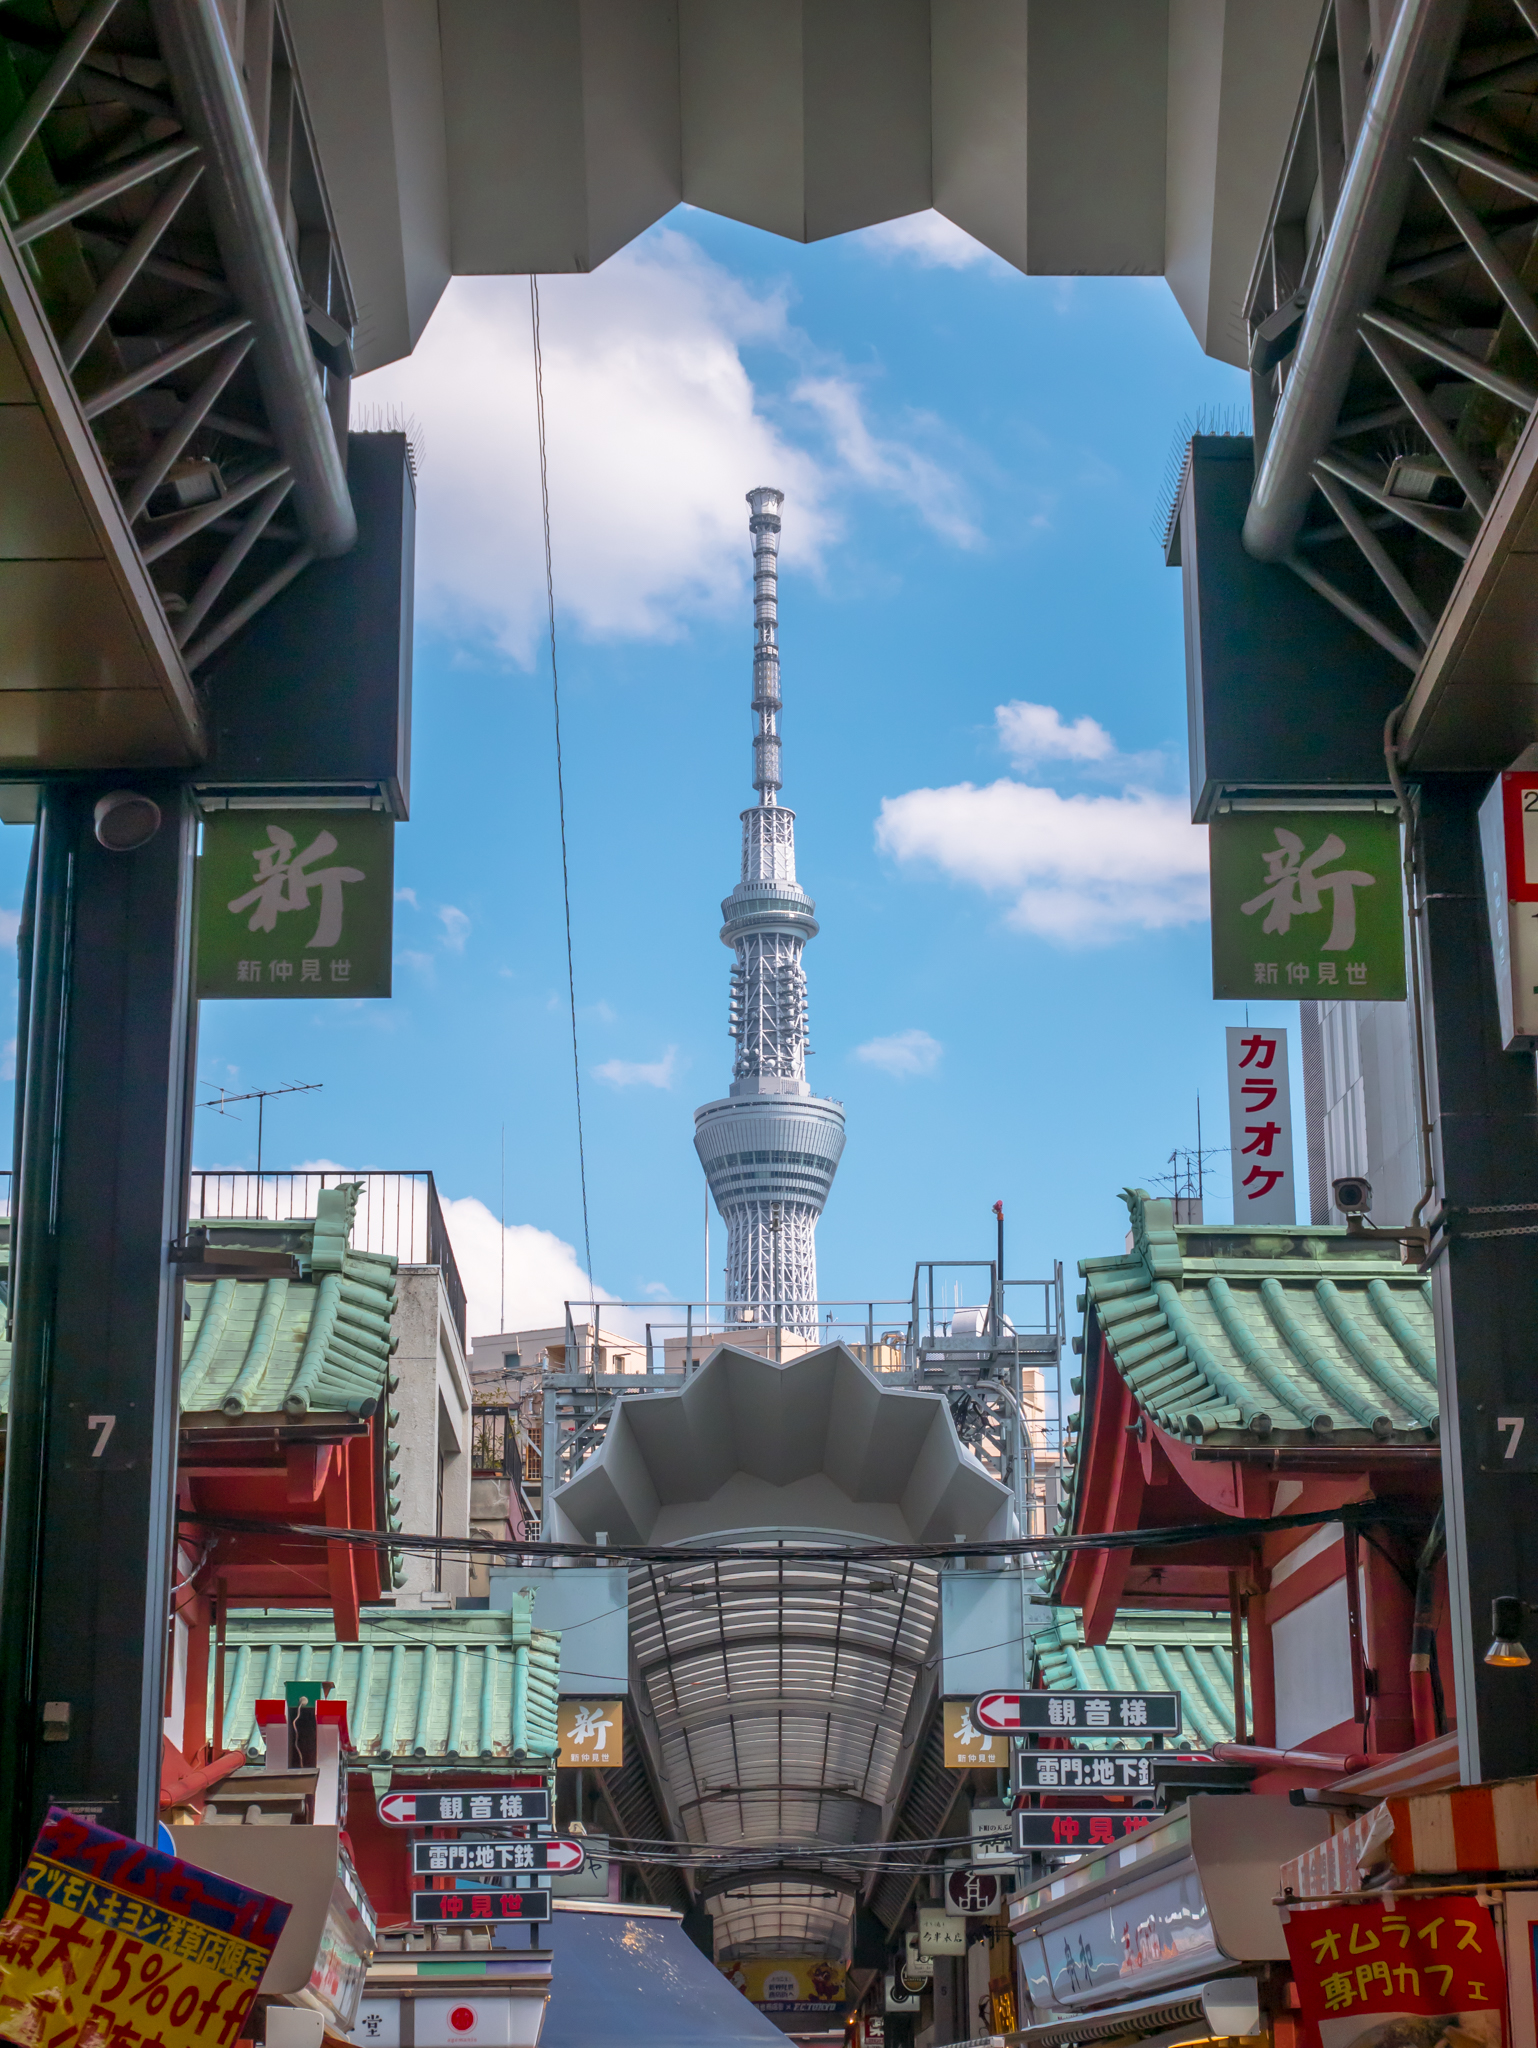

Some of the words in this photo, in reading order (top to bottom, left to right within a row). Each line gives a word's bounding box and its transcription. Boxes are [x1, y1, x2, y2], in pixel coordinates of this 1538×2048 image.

[228, 825, 366, 948] 新
[1240, 827, 1376, 951] 新
[237, 959, 352, 982] 新仲見世
[1254, 962, 1368, 985] 新仲見世
[1238, 1034, 1284, 1200] カラオケ
[88, 1415, 116, 1457] 7
[1497, 1417, 1525, 1458] 7
[567, 1705, 613, 1750] 新
[1048, 1698, 1148, 1727] 観音様
[570, 1753, 610, 1763] 新仲見世
[957, 1753, 996, 1763] 新仲見世
[439, 1795, 523, 1819] 観音様
[46, 1816, 281, 1947] タイムセール
[25, 1861, 269, 1984] マツモトキヨシ浅草店限定
[439, 1894, 523, 1919] 仲見世
[1310, 1916, 1482, 1965] オムライス
[1320, 1961, 1489, 2011] 専門カフェ
[362, 2014, 382, 2037] 堂
